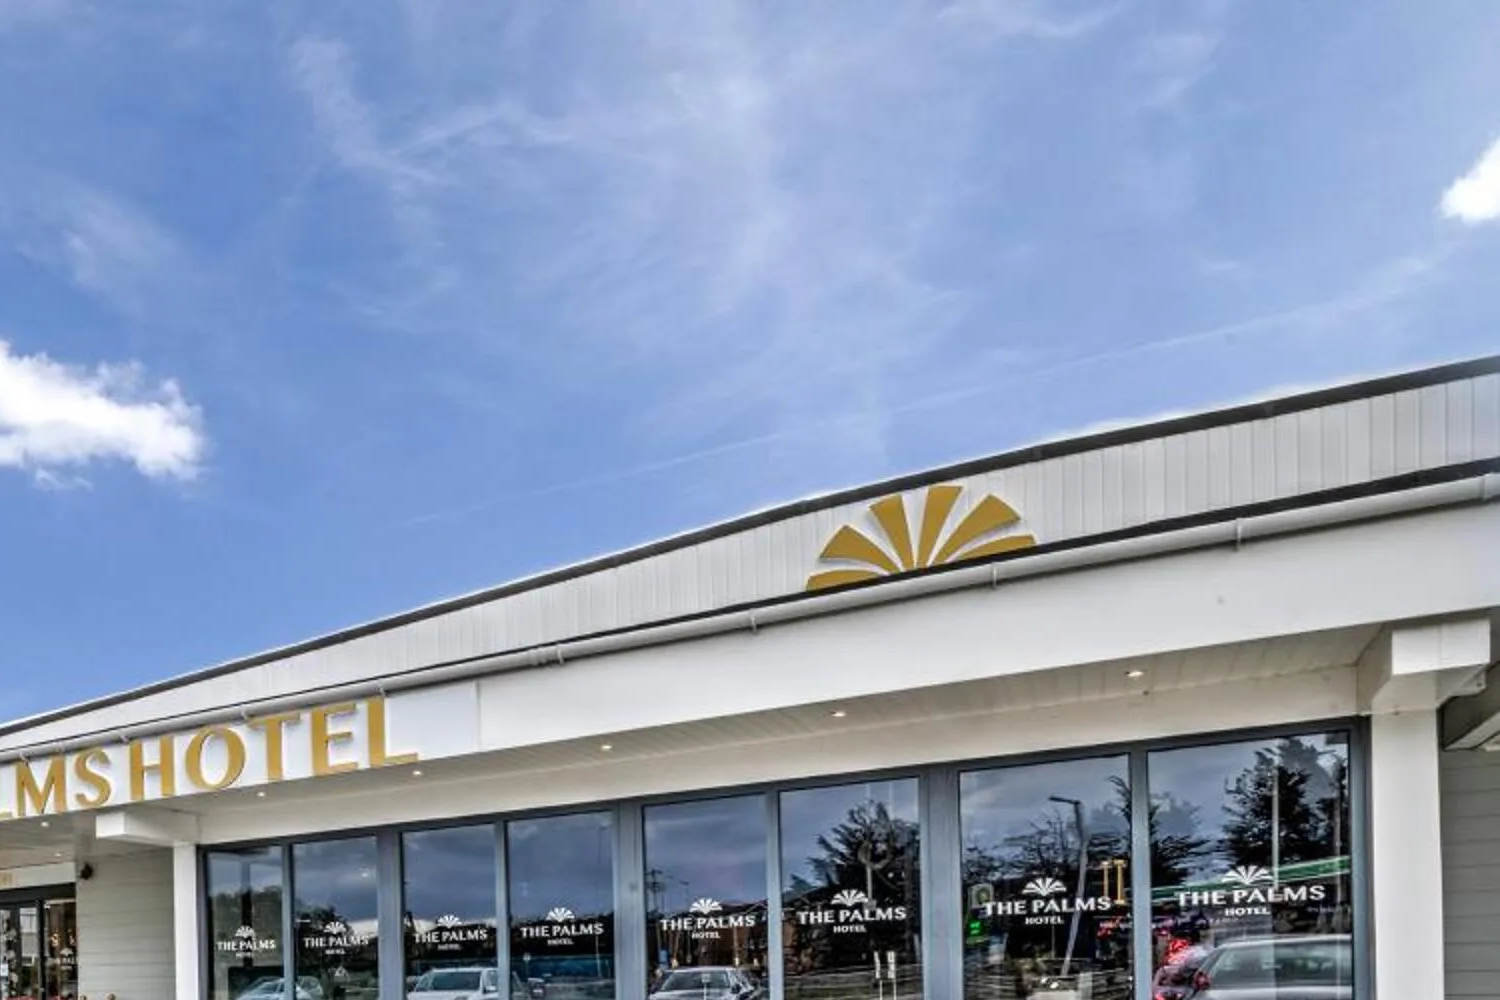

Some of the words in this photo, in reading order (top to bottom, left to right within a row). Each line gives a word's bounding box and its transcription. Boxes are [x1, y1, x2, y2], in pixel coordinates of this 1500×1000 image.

[130, 697, 419, 802] HOTEL
[1177, 889, 1227, 907] THE
[1233, 885, 1326, 903] PALMS
[984, 900, 1027, 917] THE
[1032, 896, 1112, 914] PALMS
[1224, 906, 1271, 917] HOTEL
[660, 917, 693, 931] THE
[696, 914, 756, 930] PALMS
[797, 910, 835, 925] THE
[839, 906, 907, 923] PALMS
[1025, 916, 1065, 925] HOTEL
[520, 925, 550, 938] THE
[552, 922, 604, 937] PALMS
[691, 931, 720, 939] HOTEL
[833, 924, 867, 933] HOTEL
[304, 937, 328, 948] THE
[329, 935, 369, 947] PALMS
[413, 931, 440, 944] THE
[441, 929, 488, 942] PALMS
[216, 941, 237, 951] THE
[239, 939, 277, 951] PALMS
